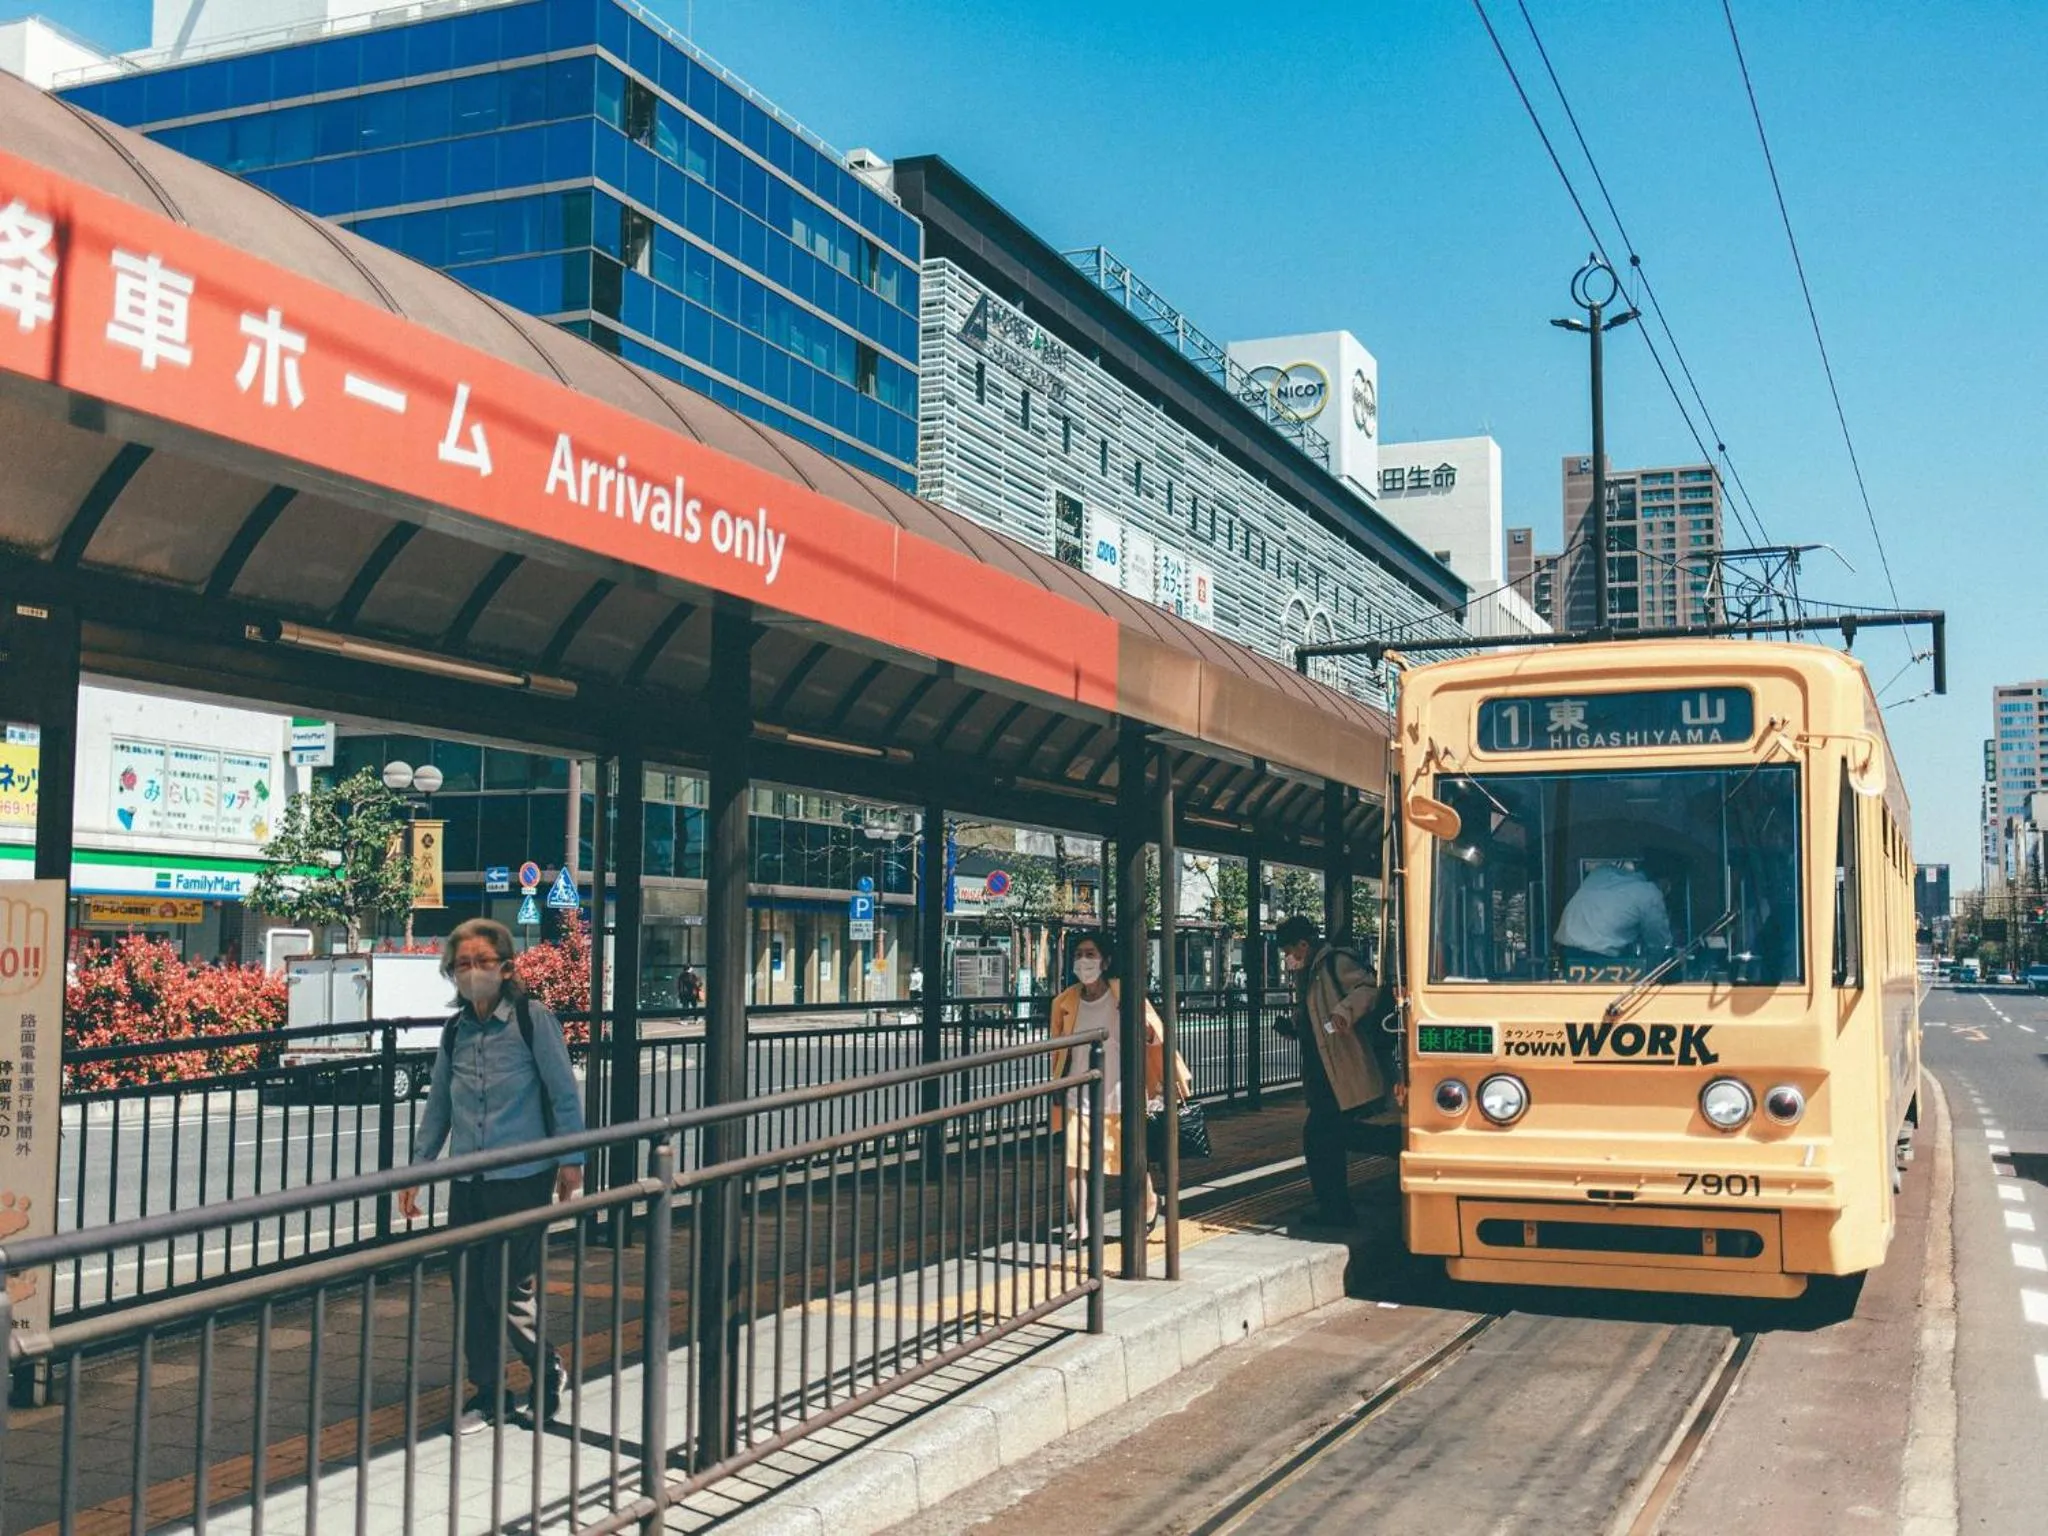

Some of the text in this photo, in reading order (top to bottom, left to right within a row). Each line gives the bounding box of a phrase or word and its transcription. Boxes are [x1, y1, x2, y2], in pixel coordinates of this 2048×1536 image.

[1277, 382, 1325, 399] NICOT
[1378, 463, 1457, 491] 田生命
[545, 433, 787, 586] Arrivals only
[1502, 706, 1520, 745] 1
[1550, 729, 1723, 748] HIGASHIYAMA
[176, 873, 241, 893] FamilyMart
[856, 898, 870, 918] P
[1569, 965, 1642, 984] ワンマン
[1419, 1027, 1493, 1052] 乗降中
[1504, 1022, 1719, 1067] TOWN WORK
[1505, 1029, 1565, 1039] タウンワーク
[15, 1013, 36, 1157] 路面電車運行時間外
[1677, 1173, 1760, 1197] 7901
